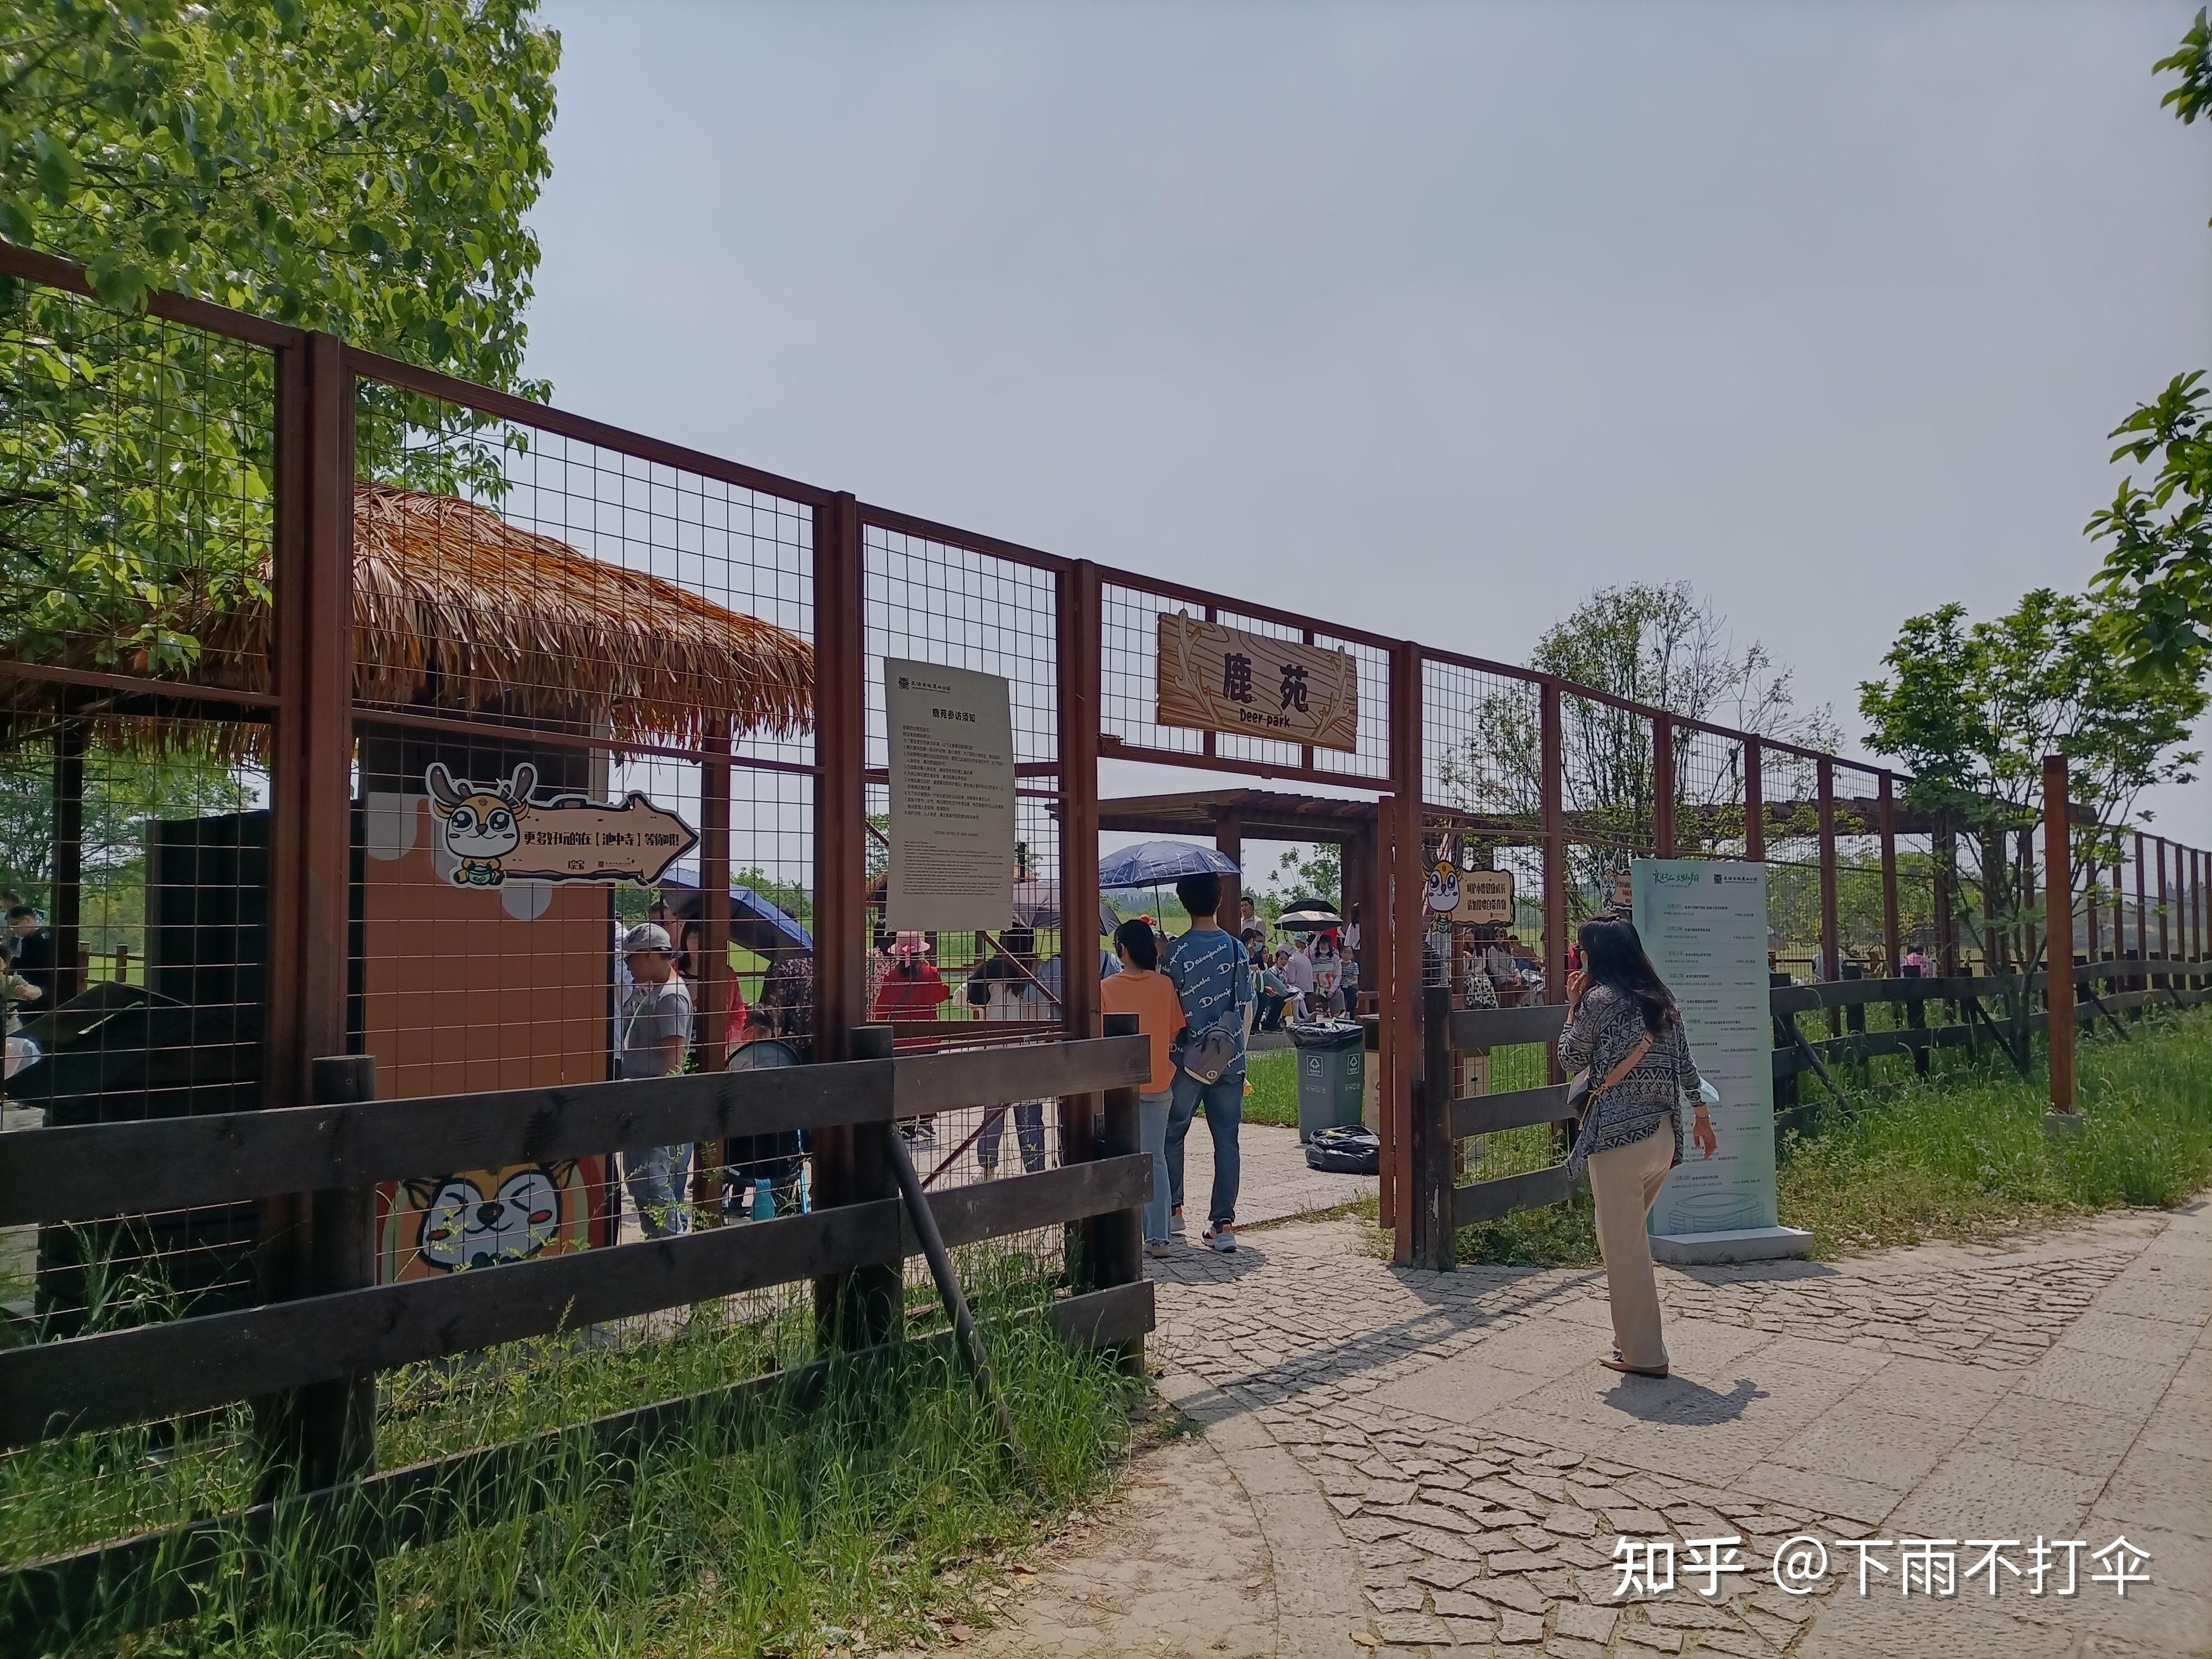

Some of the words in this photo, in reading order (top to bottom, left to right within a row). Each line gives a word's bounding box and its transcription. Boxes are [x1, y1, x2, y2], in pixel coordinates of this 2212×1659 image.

[1223, 652, 1308, 713] 鹿苑
[932, 707, 975, 723] 鹿苑参访须知
[1240, 708, 1263, 723] Deer
[1266, 714, 1290, 728] park
